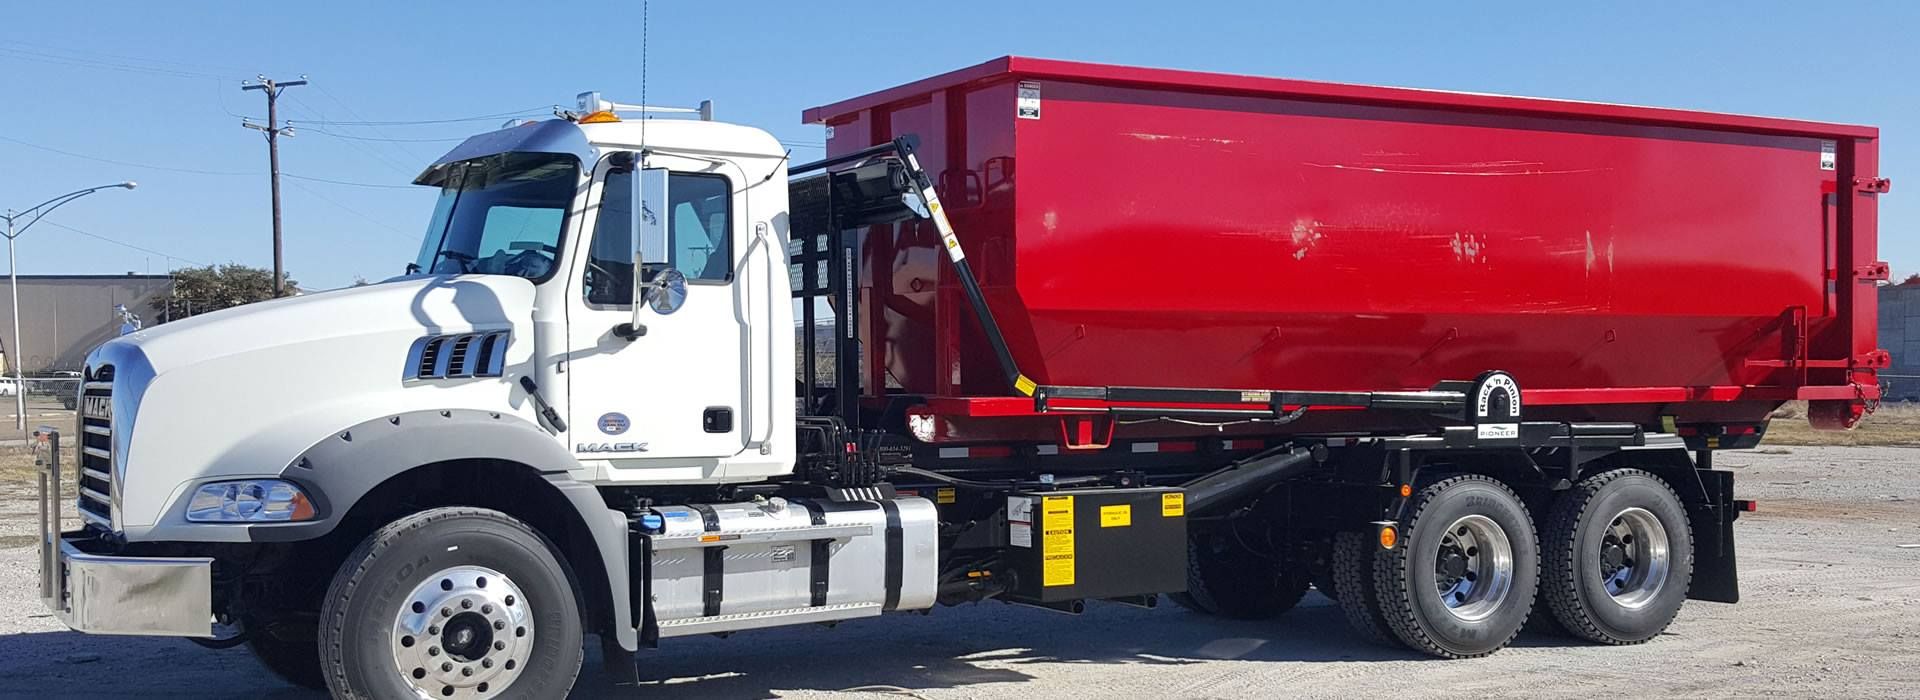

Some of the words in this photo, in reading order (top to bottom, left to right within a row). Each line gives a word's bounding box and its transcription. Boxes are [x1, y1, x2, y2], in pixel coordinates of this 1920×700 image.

[1479, 382, 1493, 413] Rack
[1503, 378, 1518, 414] Pinion
[84, 397, 112, 418] MACK
[575, 442, 649, 454] MACK
